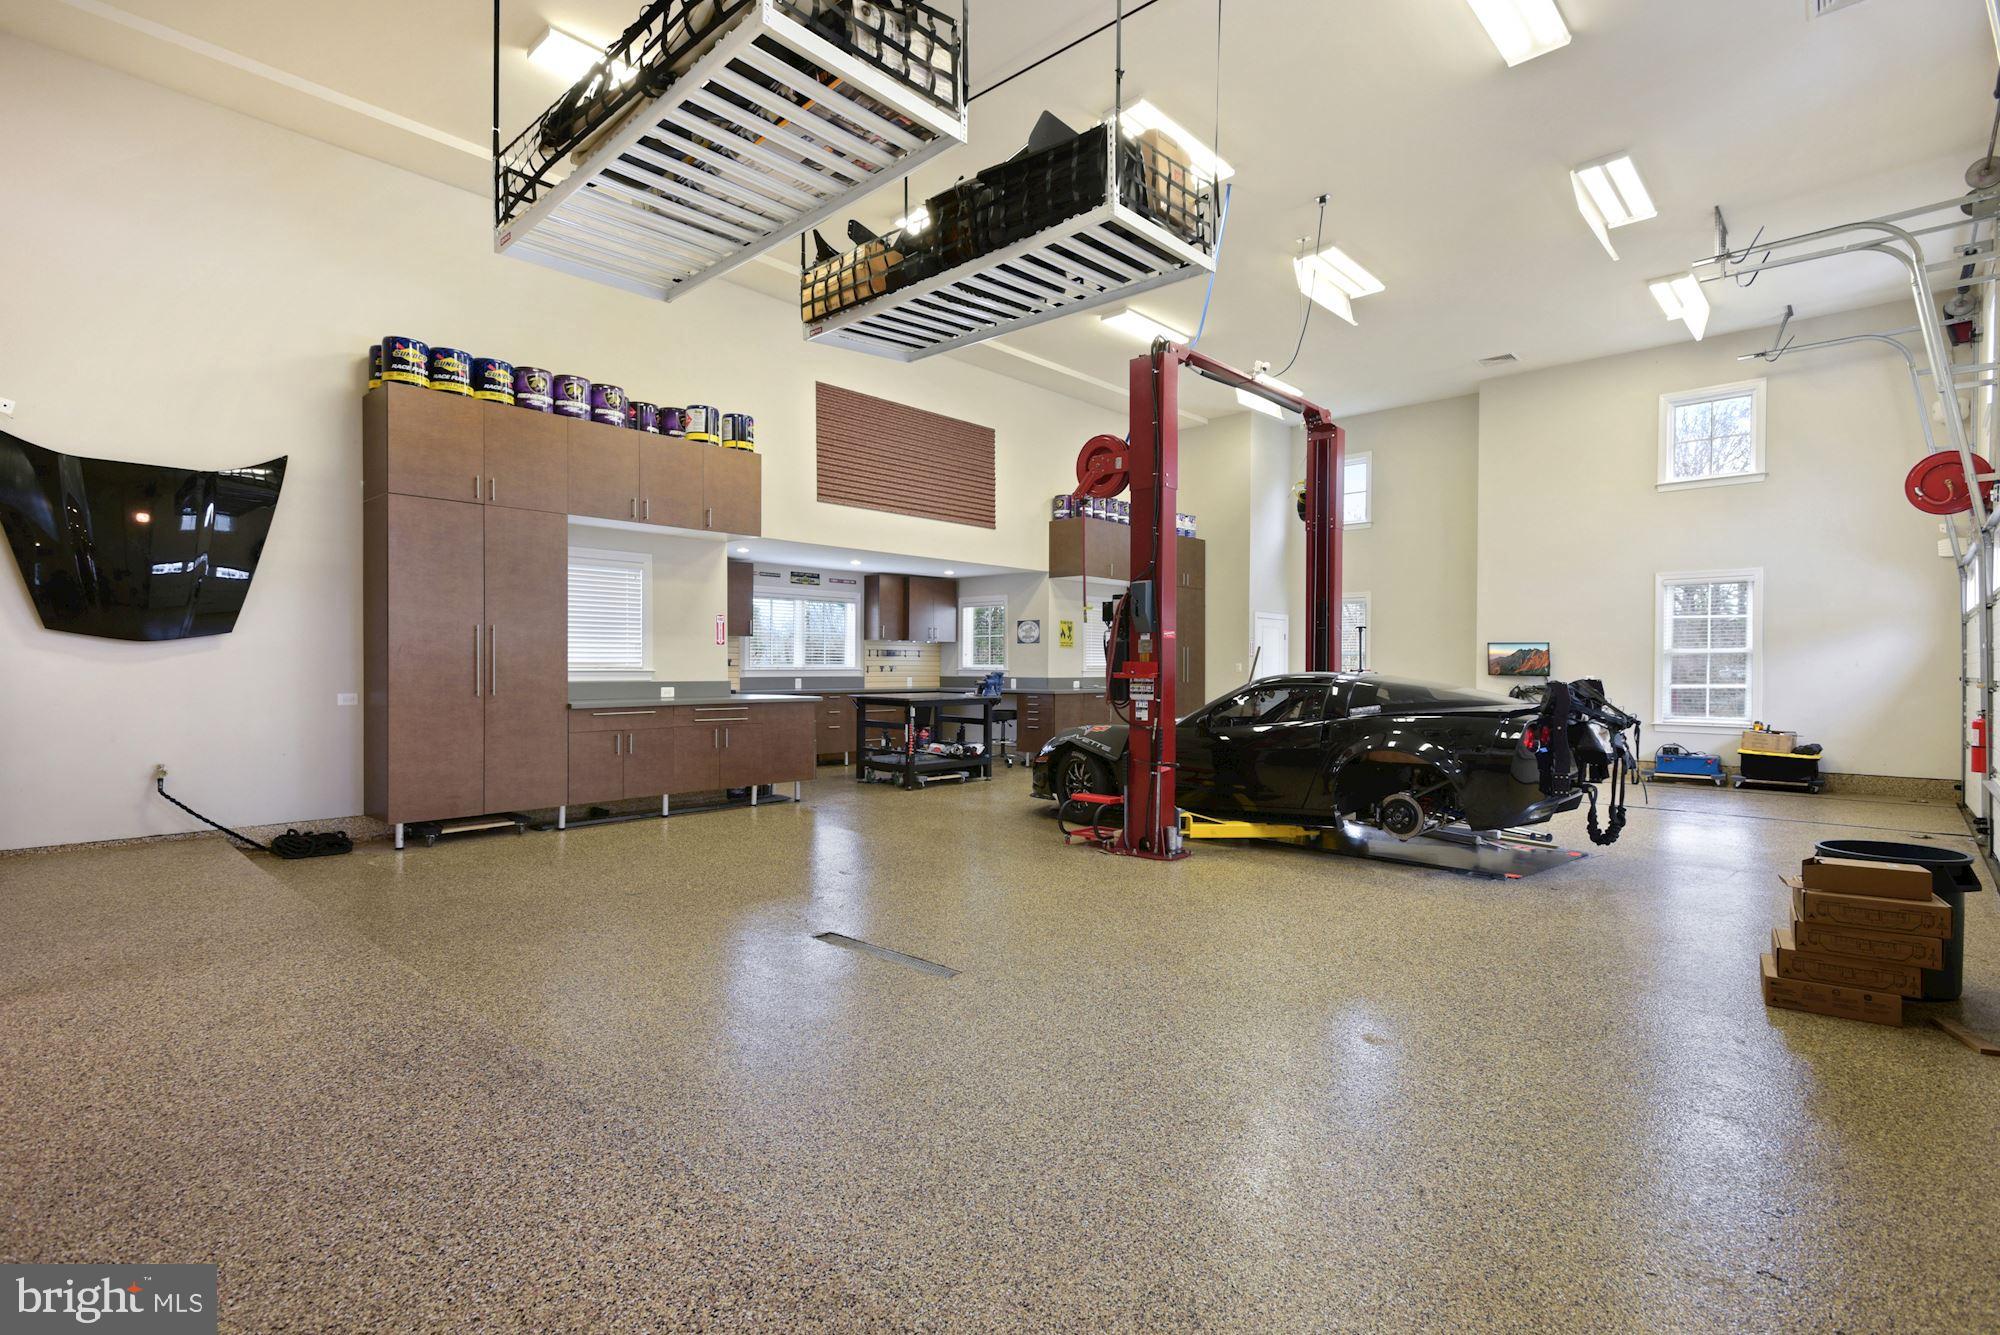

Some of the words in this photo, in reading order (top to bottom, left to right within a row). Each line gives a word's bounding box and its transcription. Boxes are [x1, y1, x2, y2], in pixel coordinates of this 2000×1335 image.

[392, 348, 428, 363] SUNOCO
[391, 363, 411, 372] RACE
[433, 359, 468, 372] SUNOCO
[483, 383, 502, 391] RACE
